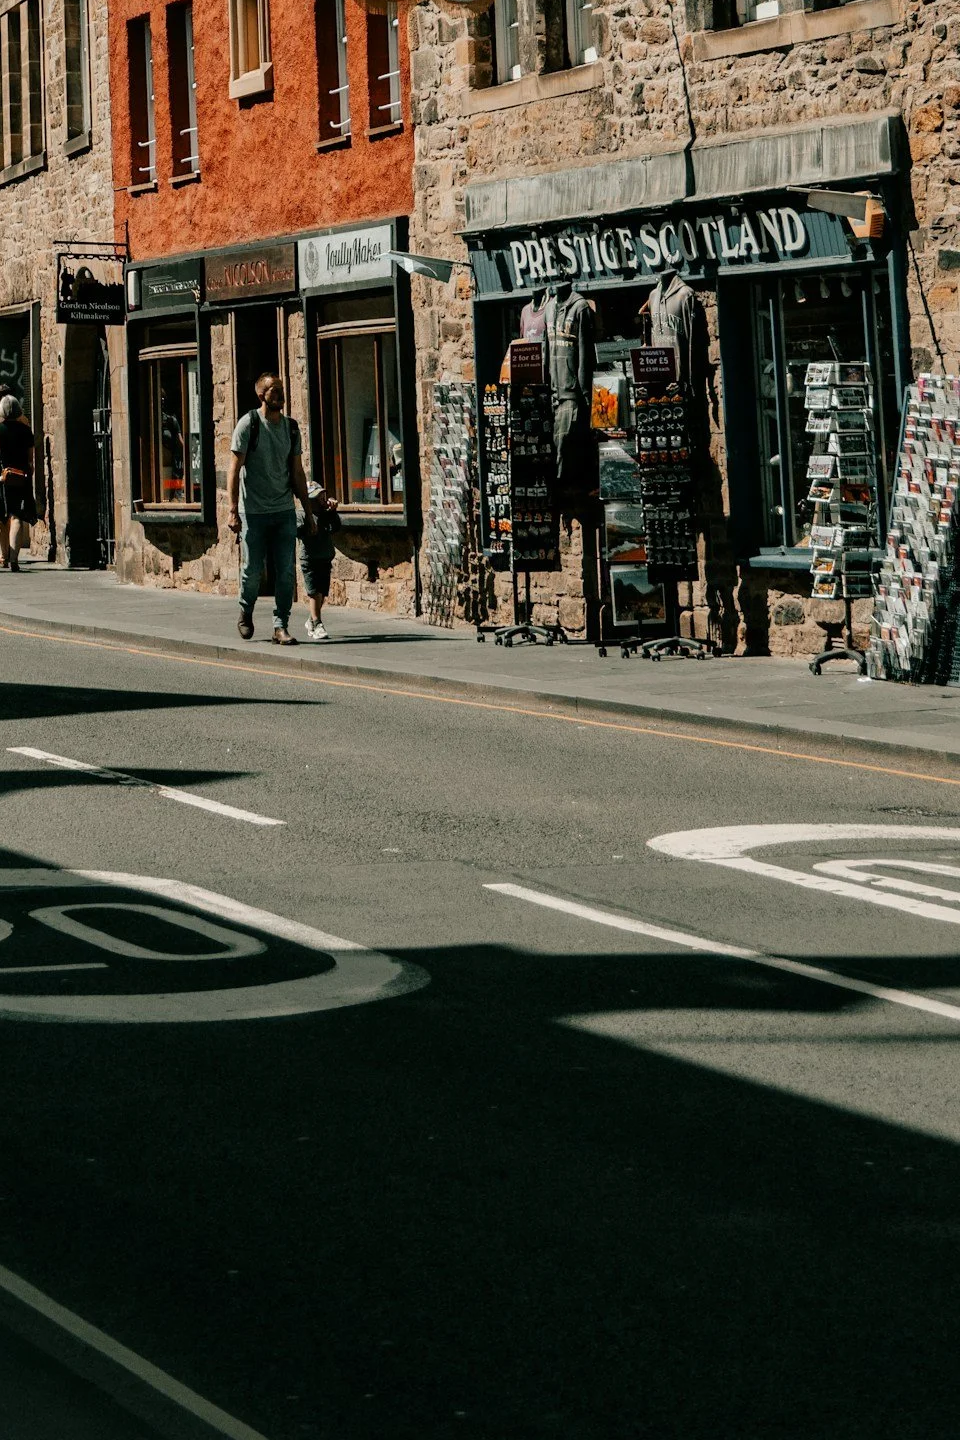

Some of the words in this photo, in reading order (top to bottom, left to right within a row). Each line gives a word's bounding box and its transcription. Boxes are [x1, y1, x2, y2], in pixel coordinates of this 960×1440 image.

[510, 226, 638, 286] PRESTIGE
[640, 207, 807, 268] SCOTLAND
[223, 259, 271, 288] NICOLSON
[70, 312, 110, 320] Kiltmakers
[646, 357, 657, 365] for
[659, 356, 669, 365] £5
